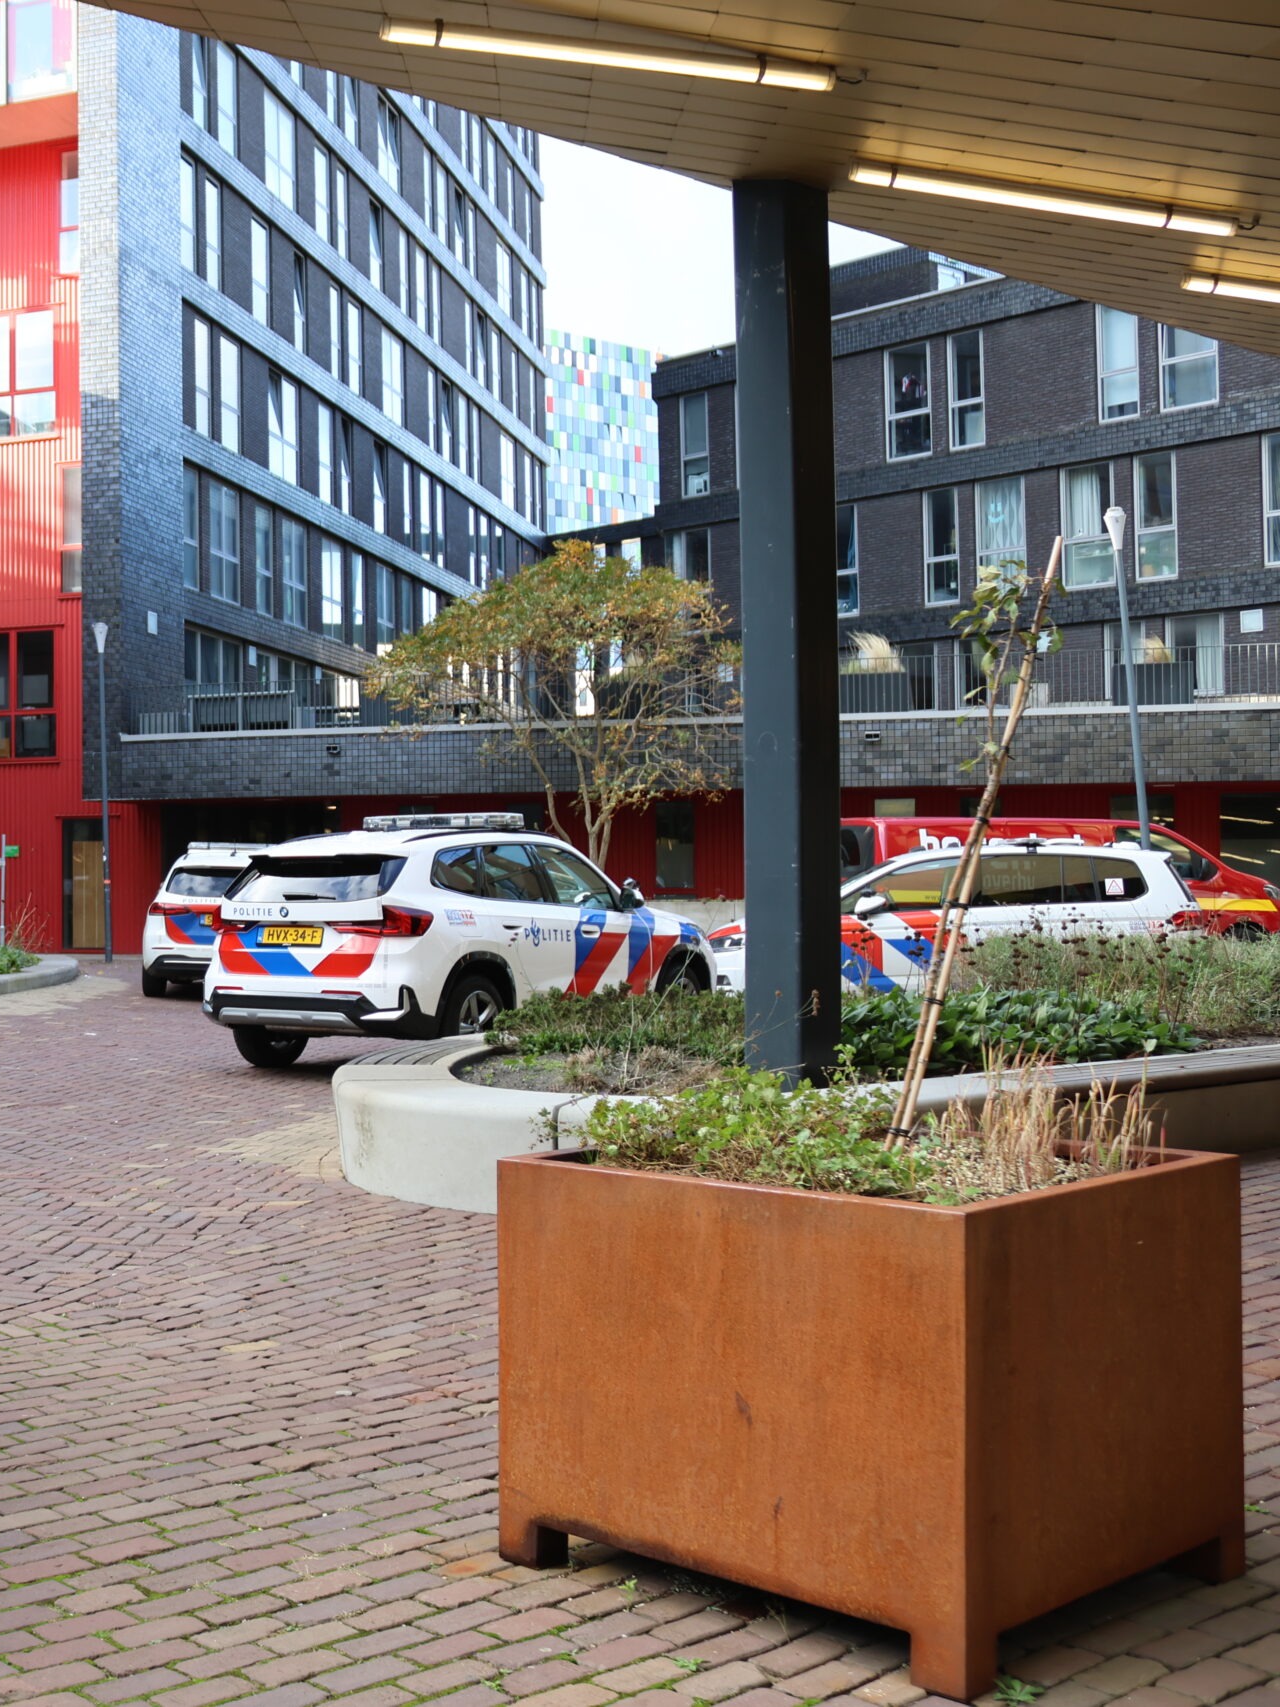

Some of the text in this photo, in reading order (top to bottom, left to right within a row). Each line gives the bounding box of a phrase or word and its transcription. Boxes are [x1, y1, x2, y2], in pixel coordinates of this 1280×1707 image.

[233, 907, 273, 917] POLITIE
[267, 928, 319, 942] HVX-34-F
[524, 920, 572, 946] POLITIE
